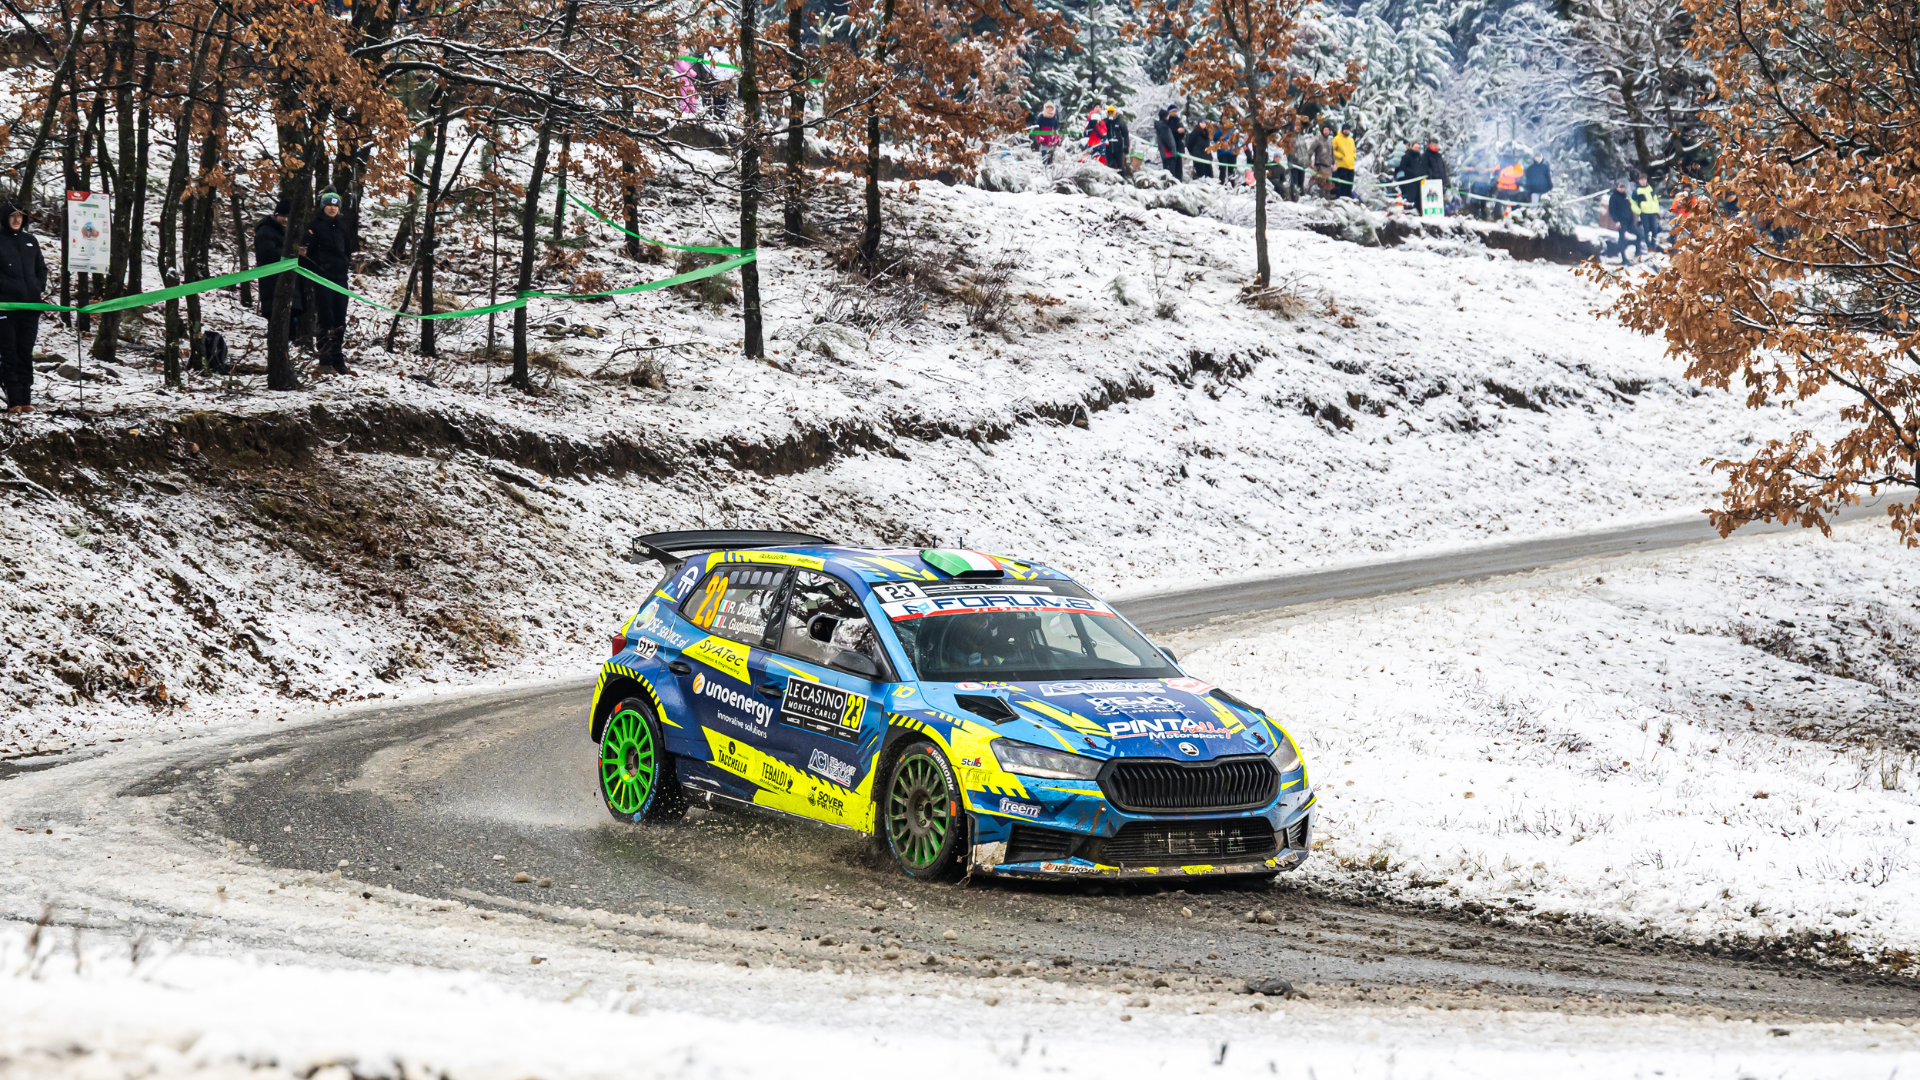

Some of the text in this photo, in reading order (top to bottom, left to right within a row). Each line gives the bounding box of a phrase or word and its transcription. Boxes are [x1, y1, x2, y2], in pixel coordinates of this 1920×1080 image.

[692, 575, 729, 628] 23
[885, 585, 916, 599] 23
[931, 596, 1095, 610] FORUM8
[705, 680, 774, 728] unoenergy
[788, 682, 844, 709] LE CASINO
[842, 694, 864, 729] 23
[717, 709, 768, 739] innovative solutions
[1107, 718, 1201, 736] PINTA
[1149, 731, 1225, 740] Motorsport
[808, 748, 829, 772] ACI
[762, 762, 788, 787] TEBALDI
[818, 791, 844, 810] SOVER
